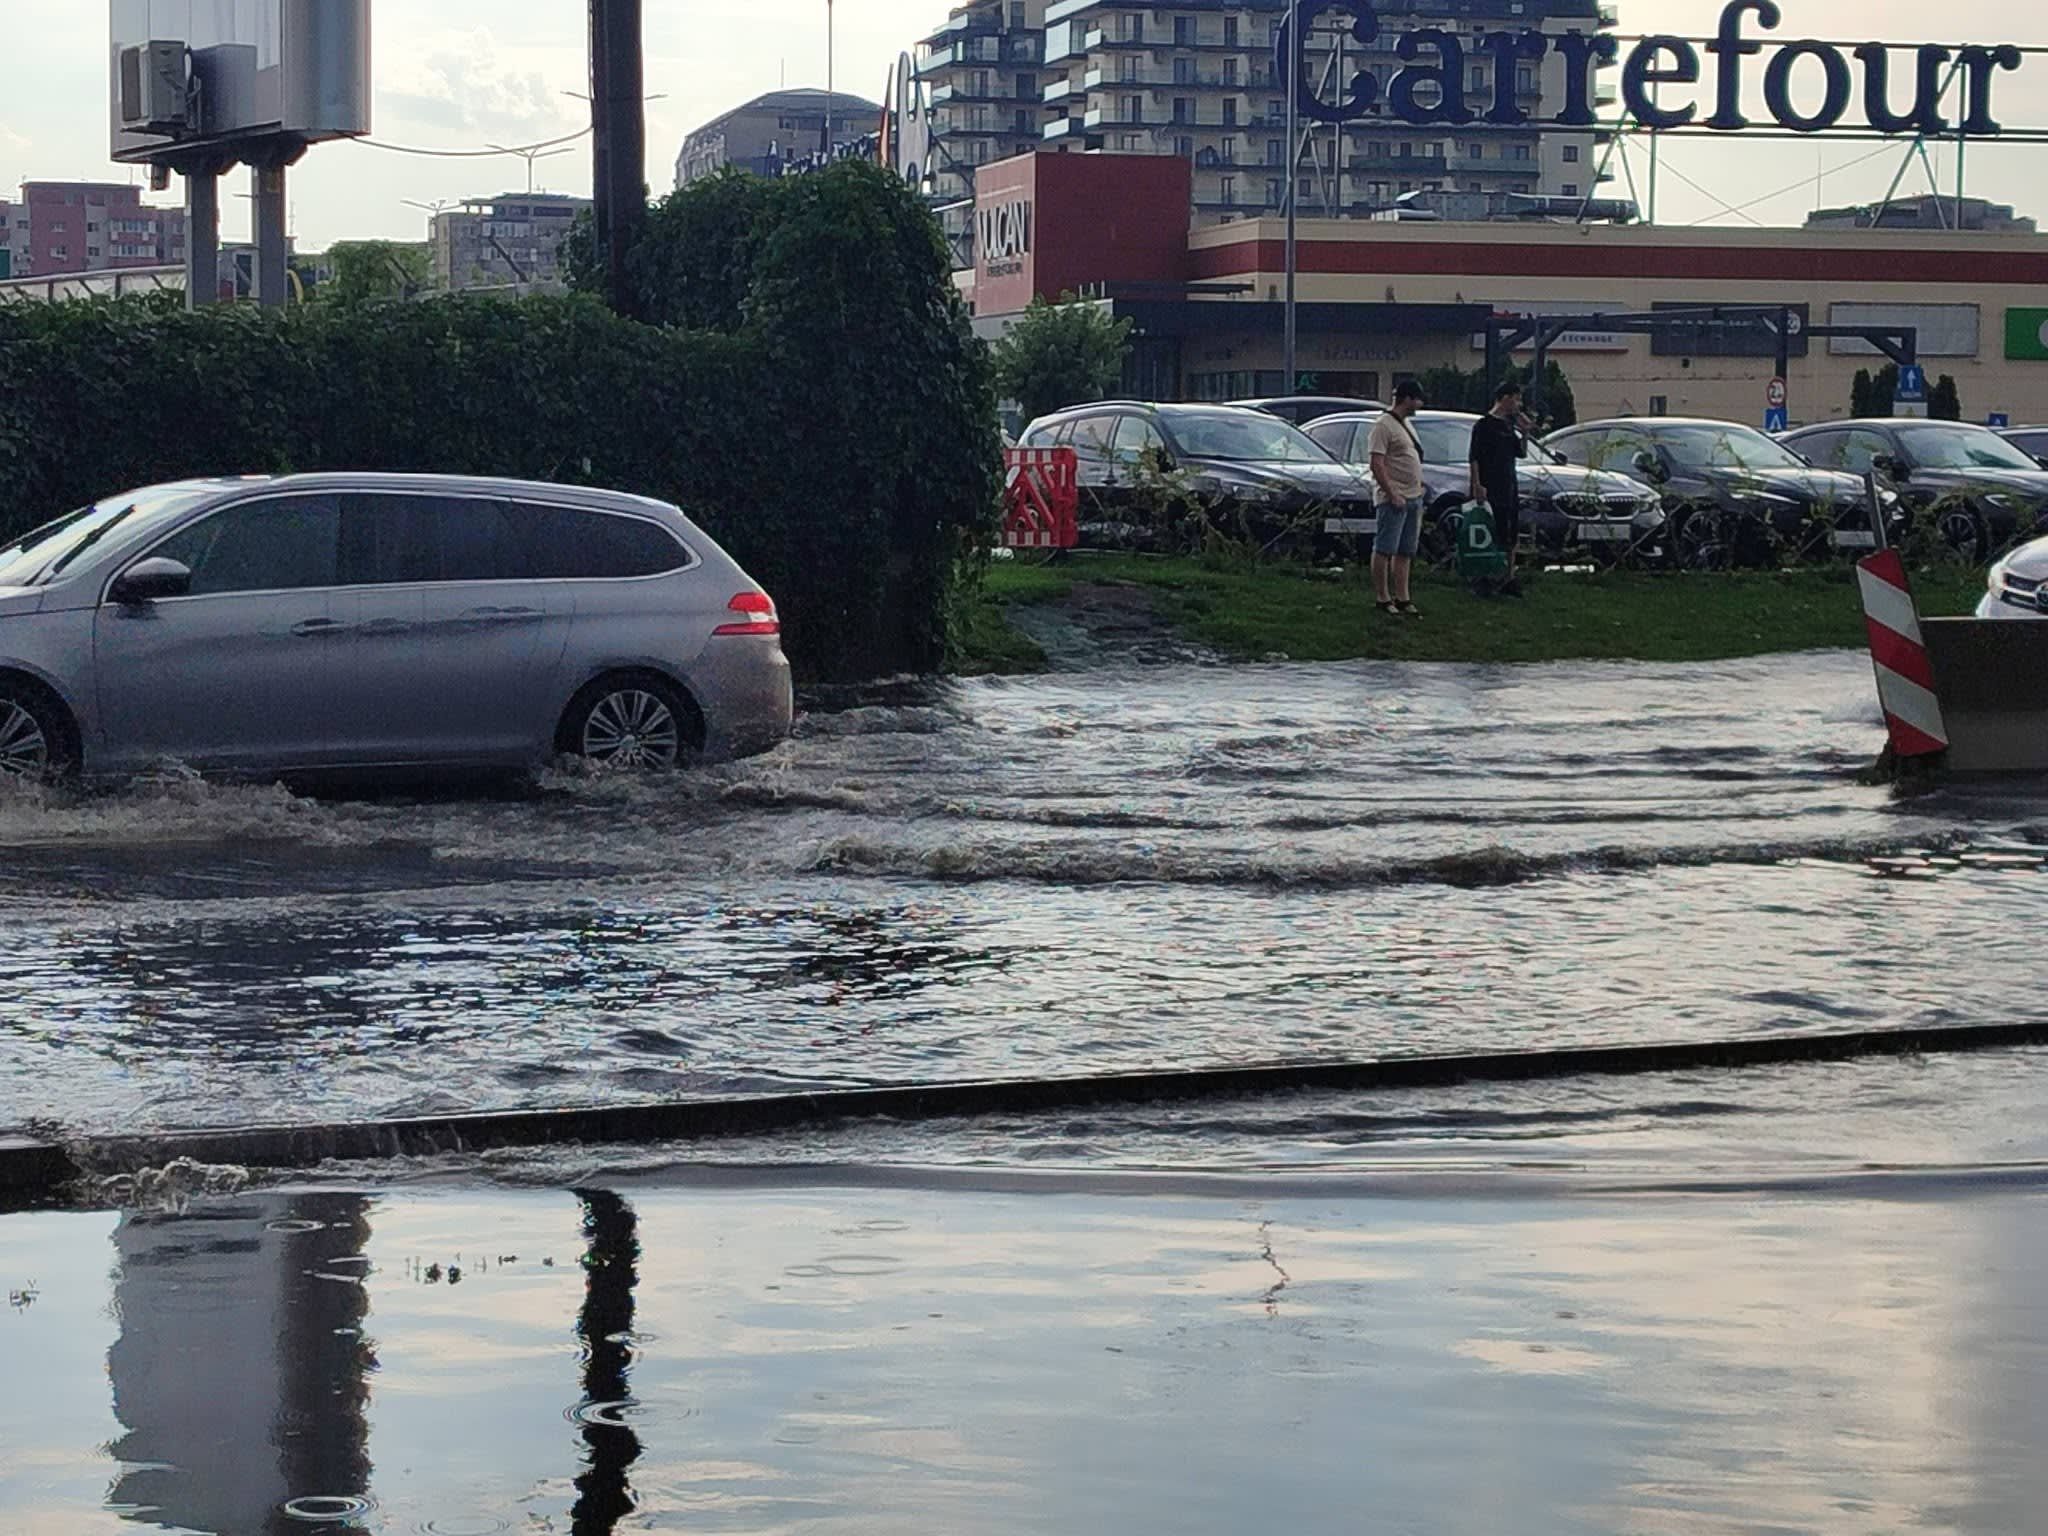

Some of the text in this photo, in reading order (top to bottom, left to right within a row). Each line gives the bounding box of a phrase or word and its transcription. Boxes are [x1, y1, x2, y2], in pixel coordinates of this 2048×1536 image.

[1275, 0, 2022, 133] Carrefour
[977, 201, 1030, 260] VULCAN
[1469, 524, 1493, 549] D
